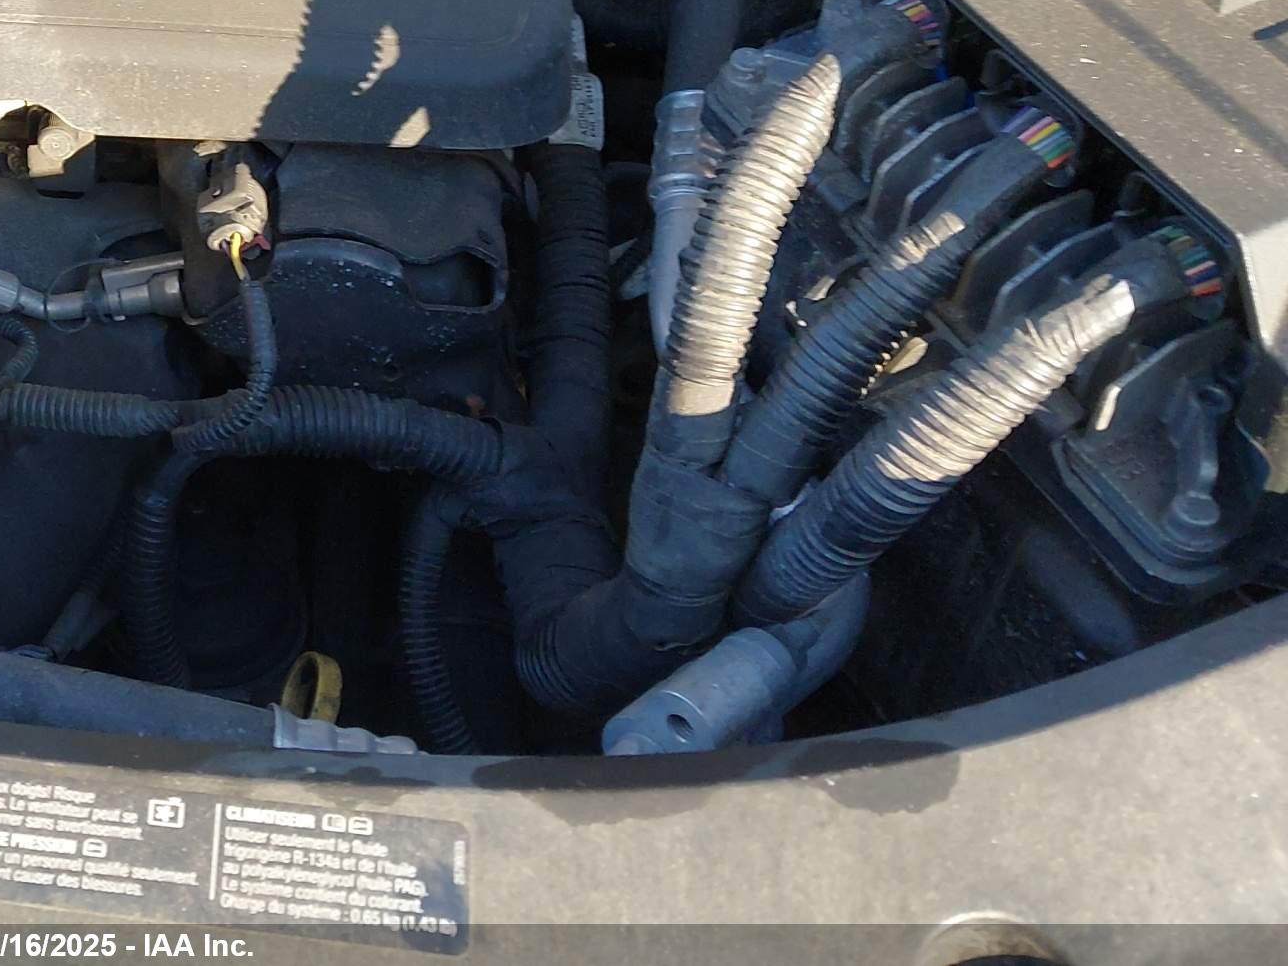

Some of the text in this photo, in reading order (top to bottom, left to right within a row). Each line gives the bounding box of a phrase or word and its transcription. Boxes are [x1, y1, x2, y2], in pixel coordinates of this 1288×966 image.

[53, 785, 96, 804] Risque
[9, 796, 26, 811] Le
[121, 812, 139, 824] se
[225, 805, 315, 828] CLIMATISEUR
[24, 816, 55, 831] sans
[10, 832, 77, 854] PRESSION
[269, 833, 336, 852] seulement
[336, 838, 350, 853] le
[3, 851, 21, 865] un
[22, 853, 83, 872] personnel
[222, 861, 240, 875] au
[292, 849, 341, 870] R-134a
[341, 856, 357, 871] et
[357, 858, 376, 873] de
[12, 869, 56, 885] causer
[56, 873, 81, 889] des
[221, 875, 238, 891] Le
[348, 891, 366, 907] du
[219, 892, 266, 915] Charge
[267, 899, 286, 914] du
